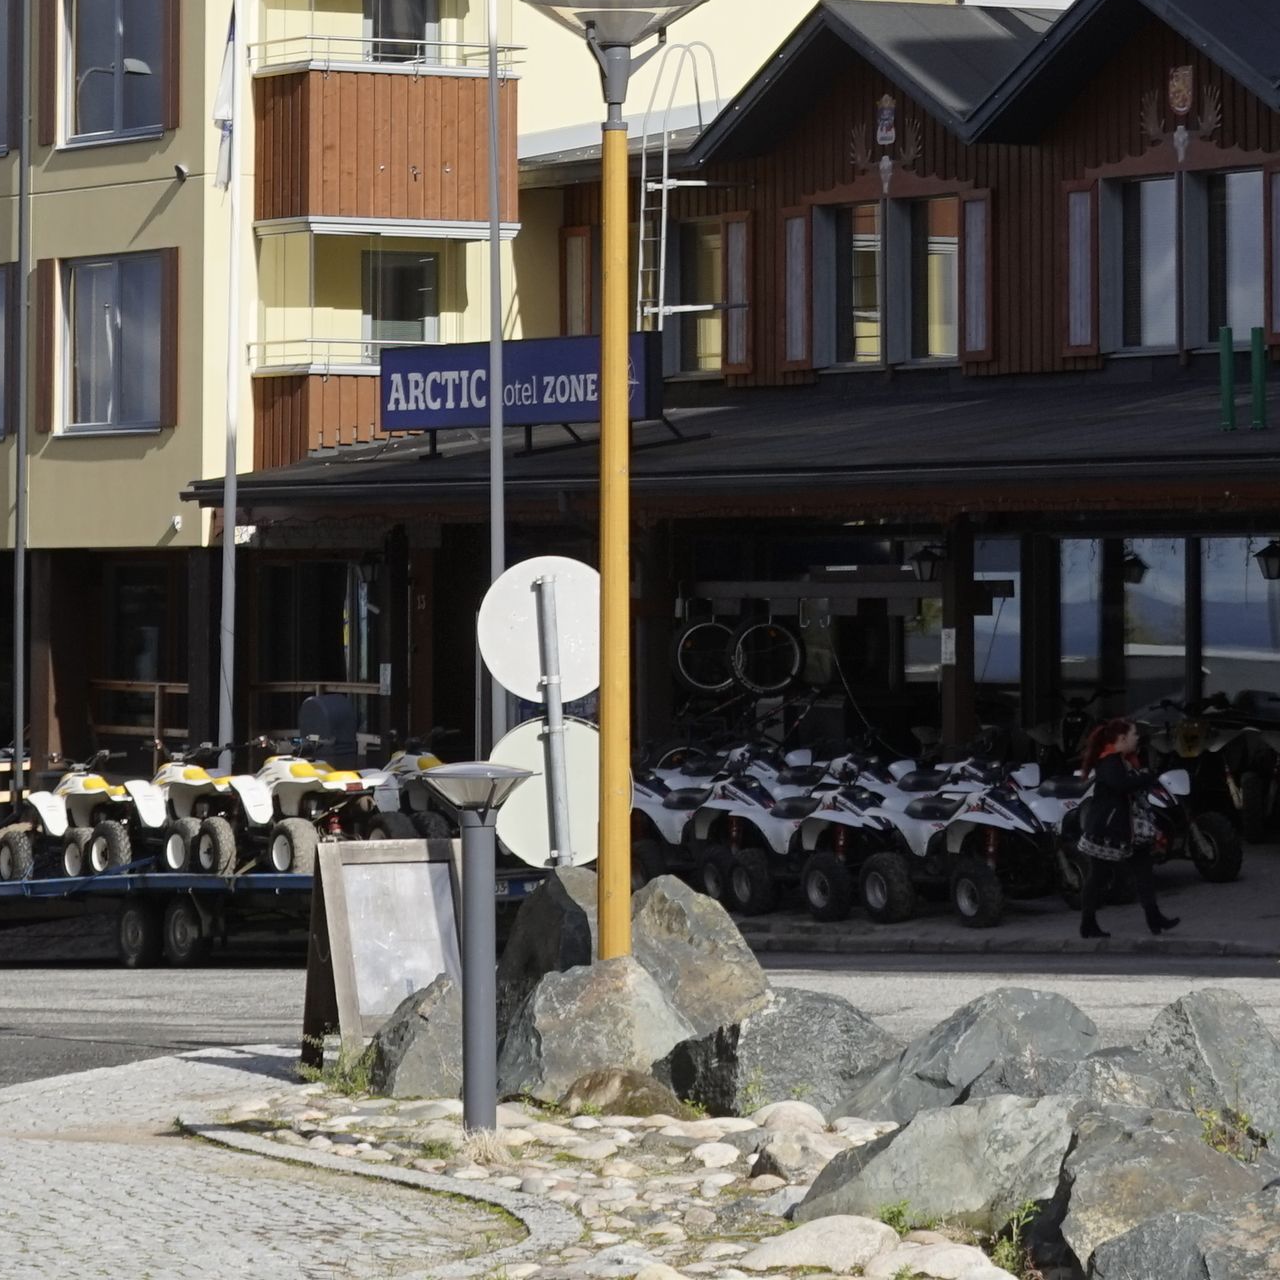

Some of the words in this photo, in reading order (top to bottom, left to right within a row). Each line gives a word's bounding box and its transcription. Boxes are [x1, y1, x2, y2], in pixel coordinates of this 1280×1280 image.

[387, 369, 487, 412] ARCTIC
[501, 376, 538, 407] otel
[542, 373, 599, 405] ZONE
